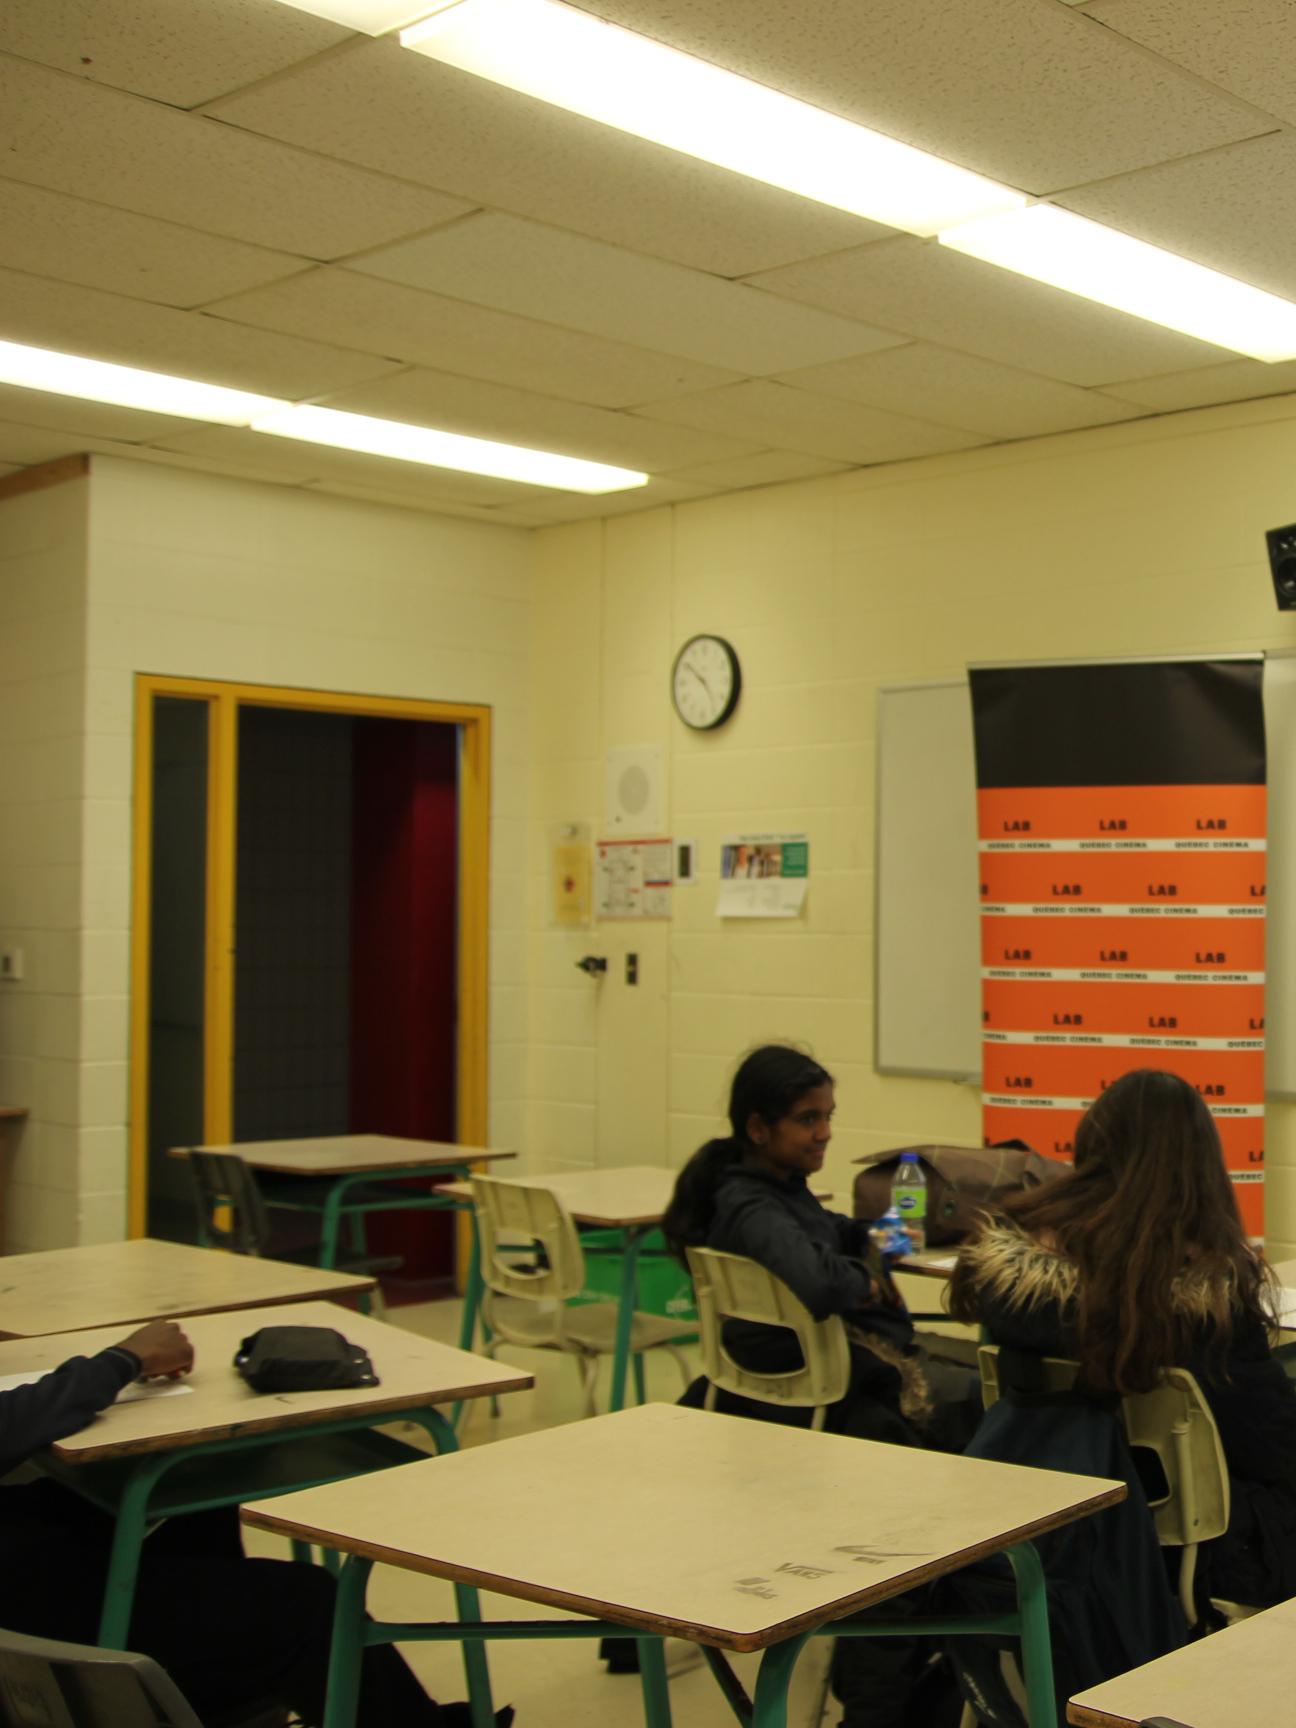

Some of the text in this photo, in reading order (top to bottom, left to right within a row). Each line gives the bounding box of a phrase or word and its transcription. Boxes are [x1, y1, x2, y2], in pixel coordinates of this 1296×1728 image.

[1003, 819, 1031, 832] LAB
[1099, 818, 1127, 831] LAB
[1195, 818, 1227, 831] LAB
[1052, 884, 1082, 896] LAB
[1147, 884, 1177, 896] LAB
[1003, 949, 1032, 961] LAB
[1099, 950, 1128, 962] LAB
[1195, 952, 1226, 964] LAB
[1053, 1013, 1083, 1026] LAB
[1148, 1016, 1177, 1028] LAB
[1005, 1076, 1033, 1088] LAB
